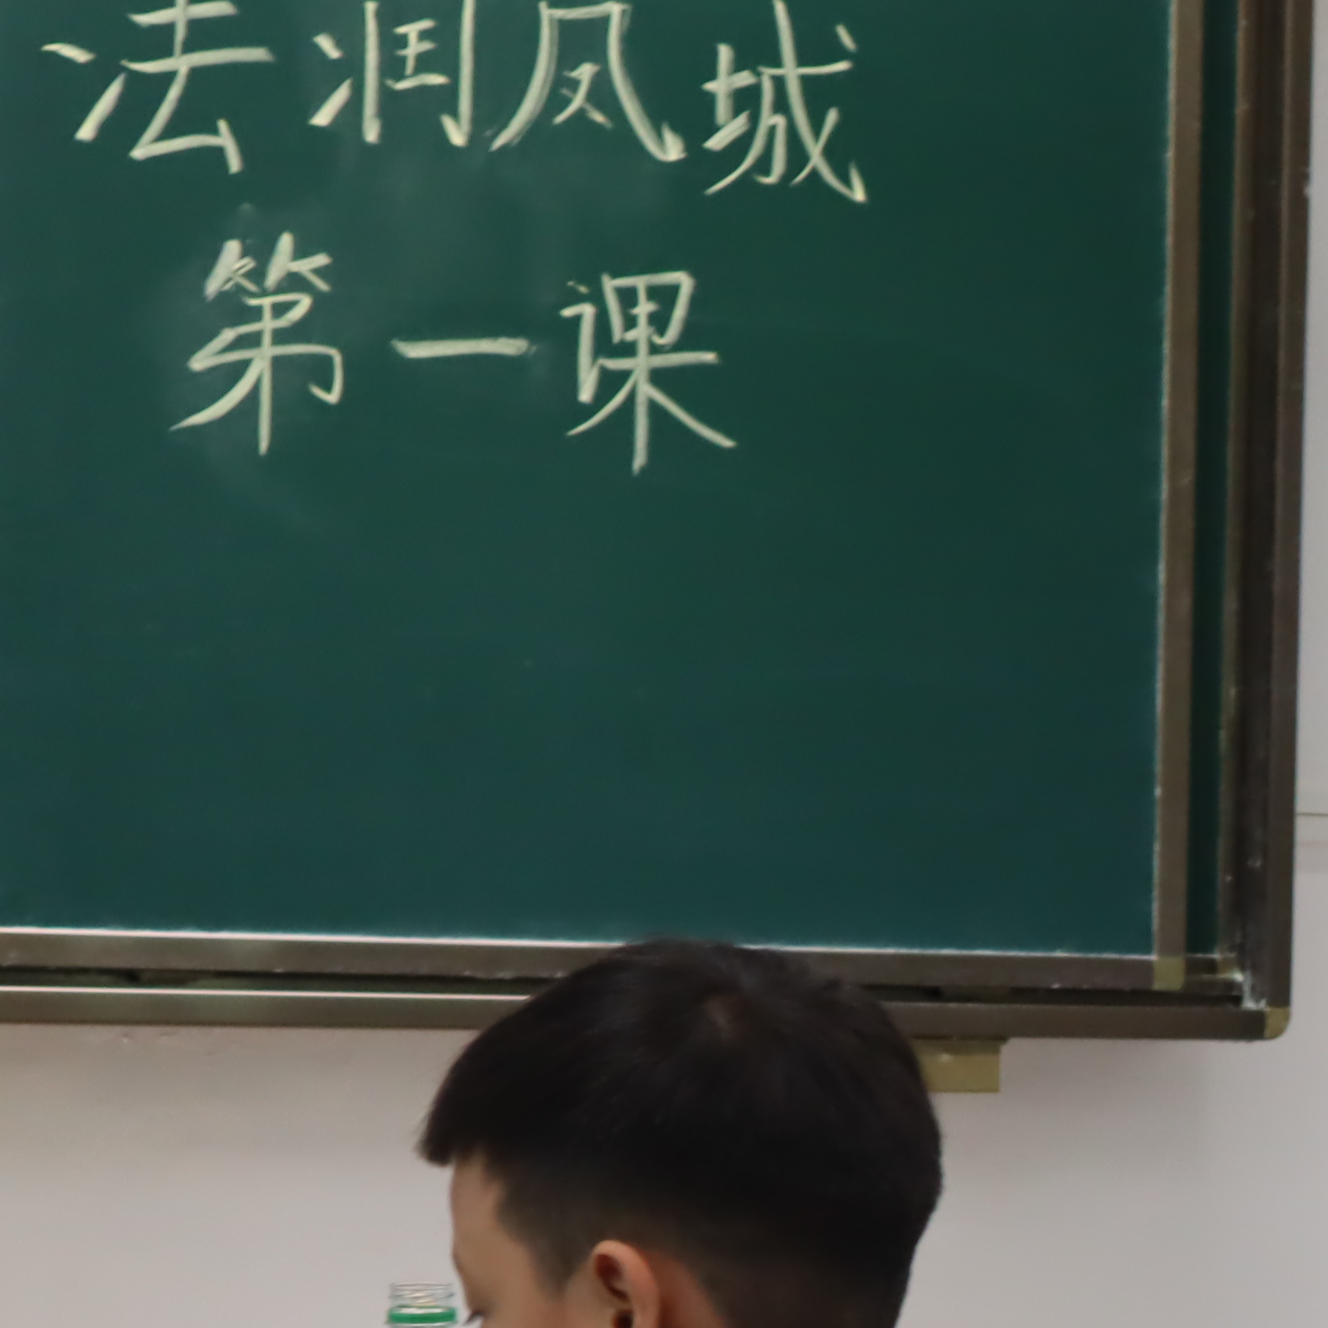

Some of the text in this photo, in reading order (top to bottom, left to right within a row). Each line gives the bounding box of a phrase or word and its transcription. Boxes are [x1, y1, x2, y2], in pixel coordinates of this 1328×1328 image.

[40, 0, 867, 203] 法润凤城
[169, 231, 738, 476] 第一课
